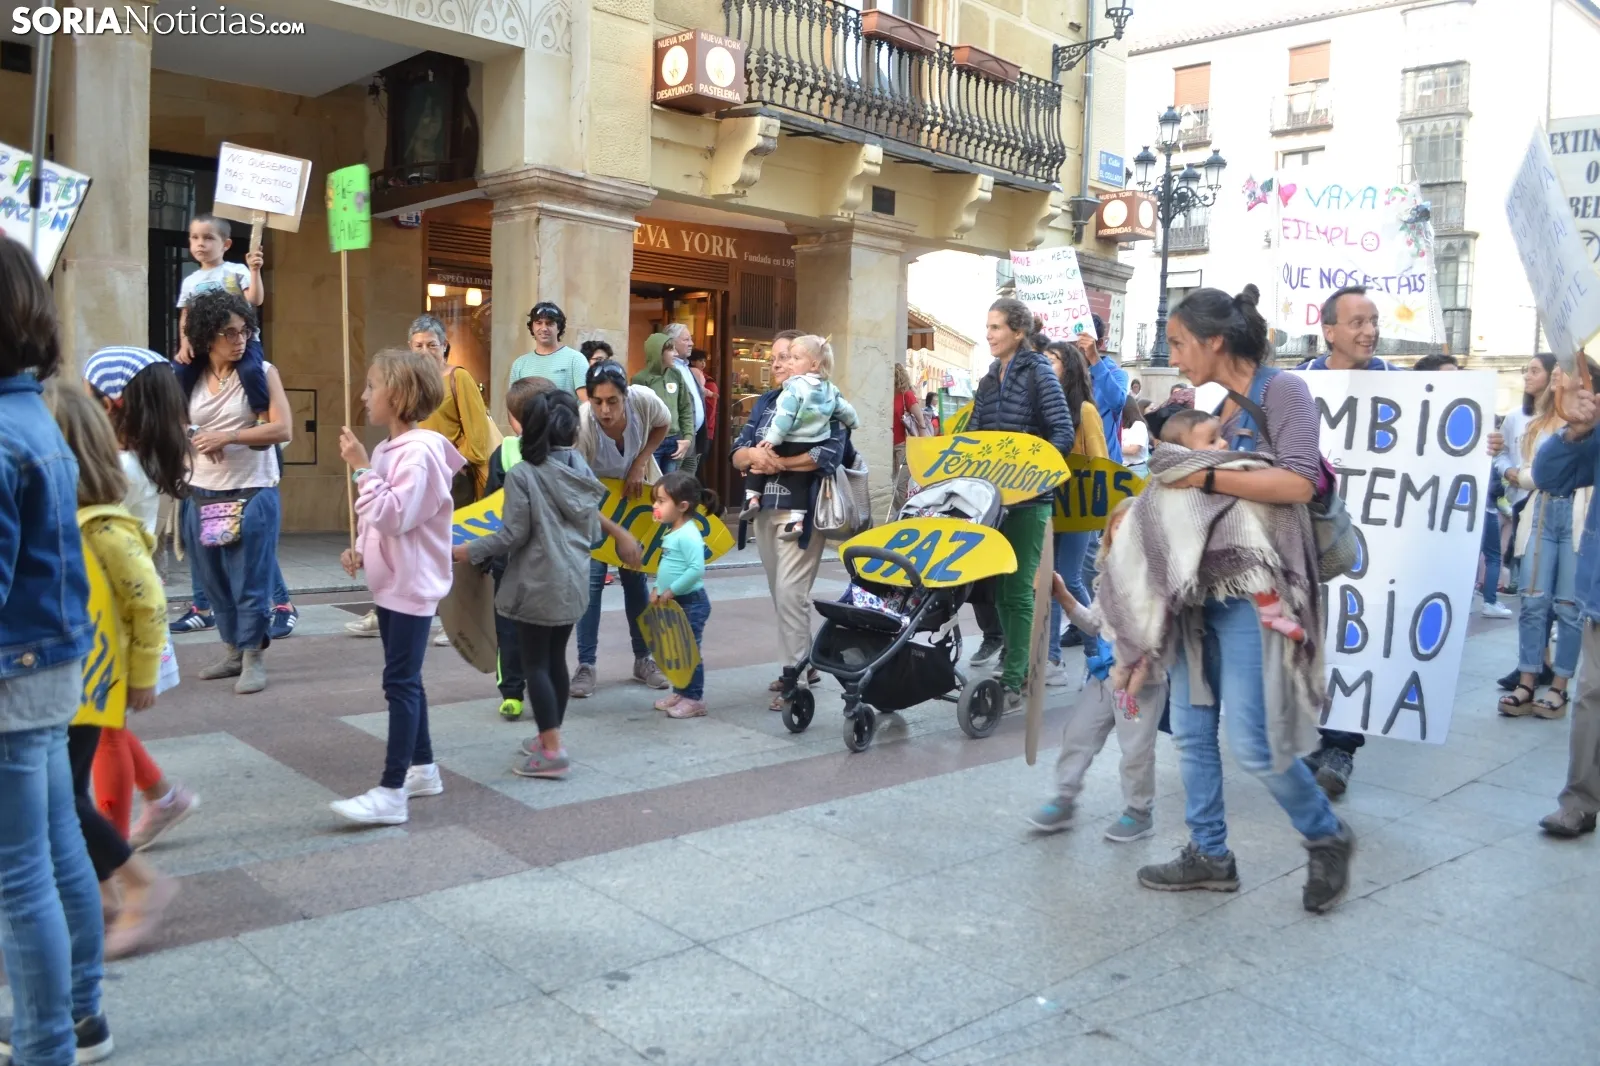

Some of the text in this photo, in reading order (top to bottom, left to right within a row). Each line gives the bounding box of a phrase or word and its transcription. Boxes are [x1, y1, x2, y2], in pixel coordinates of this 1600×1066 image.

[658, 32, 694, 48] NUEVA YORK
[701, 32, 740, 50] NUEVA YORK
[656, 84, 694, 100] DESAYUNOS
[700, 84, 740, 101] PASTELERÍA
[227, 154, 298, 175] NO QUEREMOS
[224, 184, 284, 206] EN EL MAR
[1305, 184, 1377, 209] VAYA
[680, 230, 738, 258] YORK
[1282, 218, 1380, 252] EJEMPLO
[744, 252, 771, 265] Fundada
[773, 258, 780, 266] en
[1282, 262, 1311, 290] QUE
[923, 436, 1069, 494] Feminismo
[861, 528, 985, 582] PAZ
